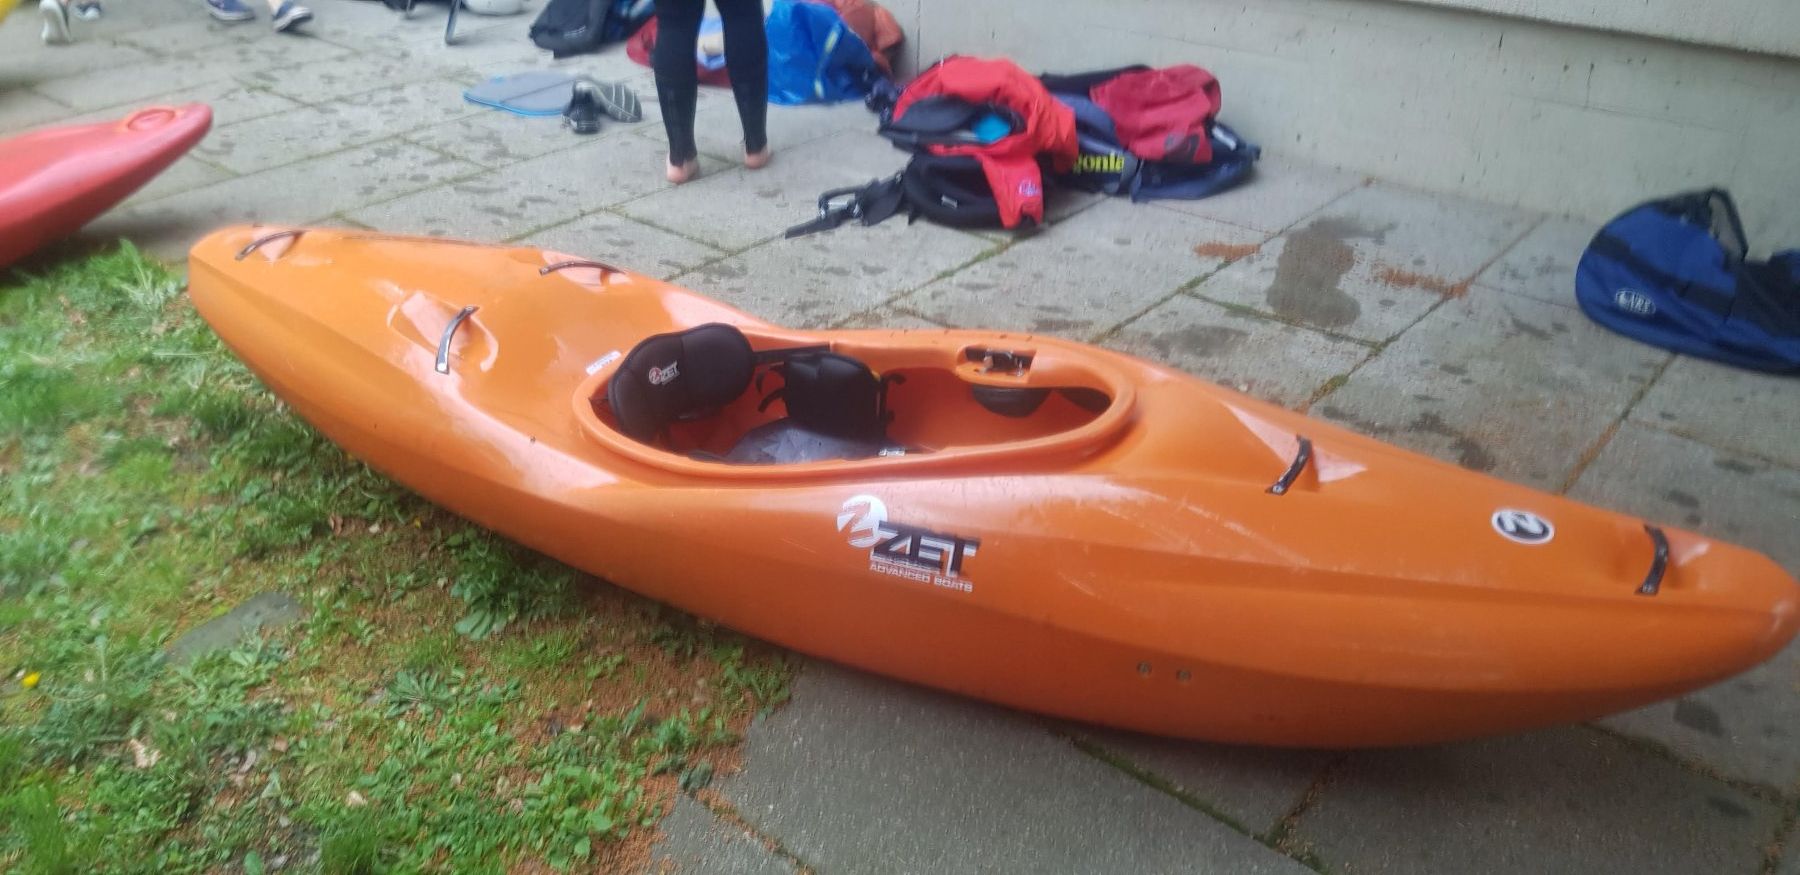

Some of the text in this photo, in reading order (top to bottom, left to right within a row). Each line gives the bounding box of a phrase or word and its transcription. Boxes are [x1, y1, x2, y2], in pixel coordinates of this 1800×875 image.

[870, 519, 981, 578] ZET
[869, 562, 974, 592] ADVANCED BOATS
